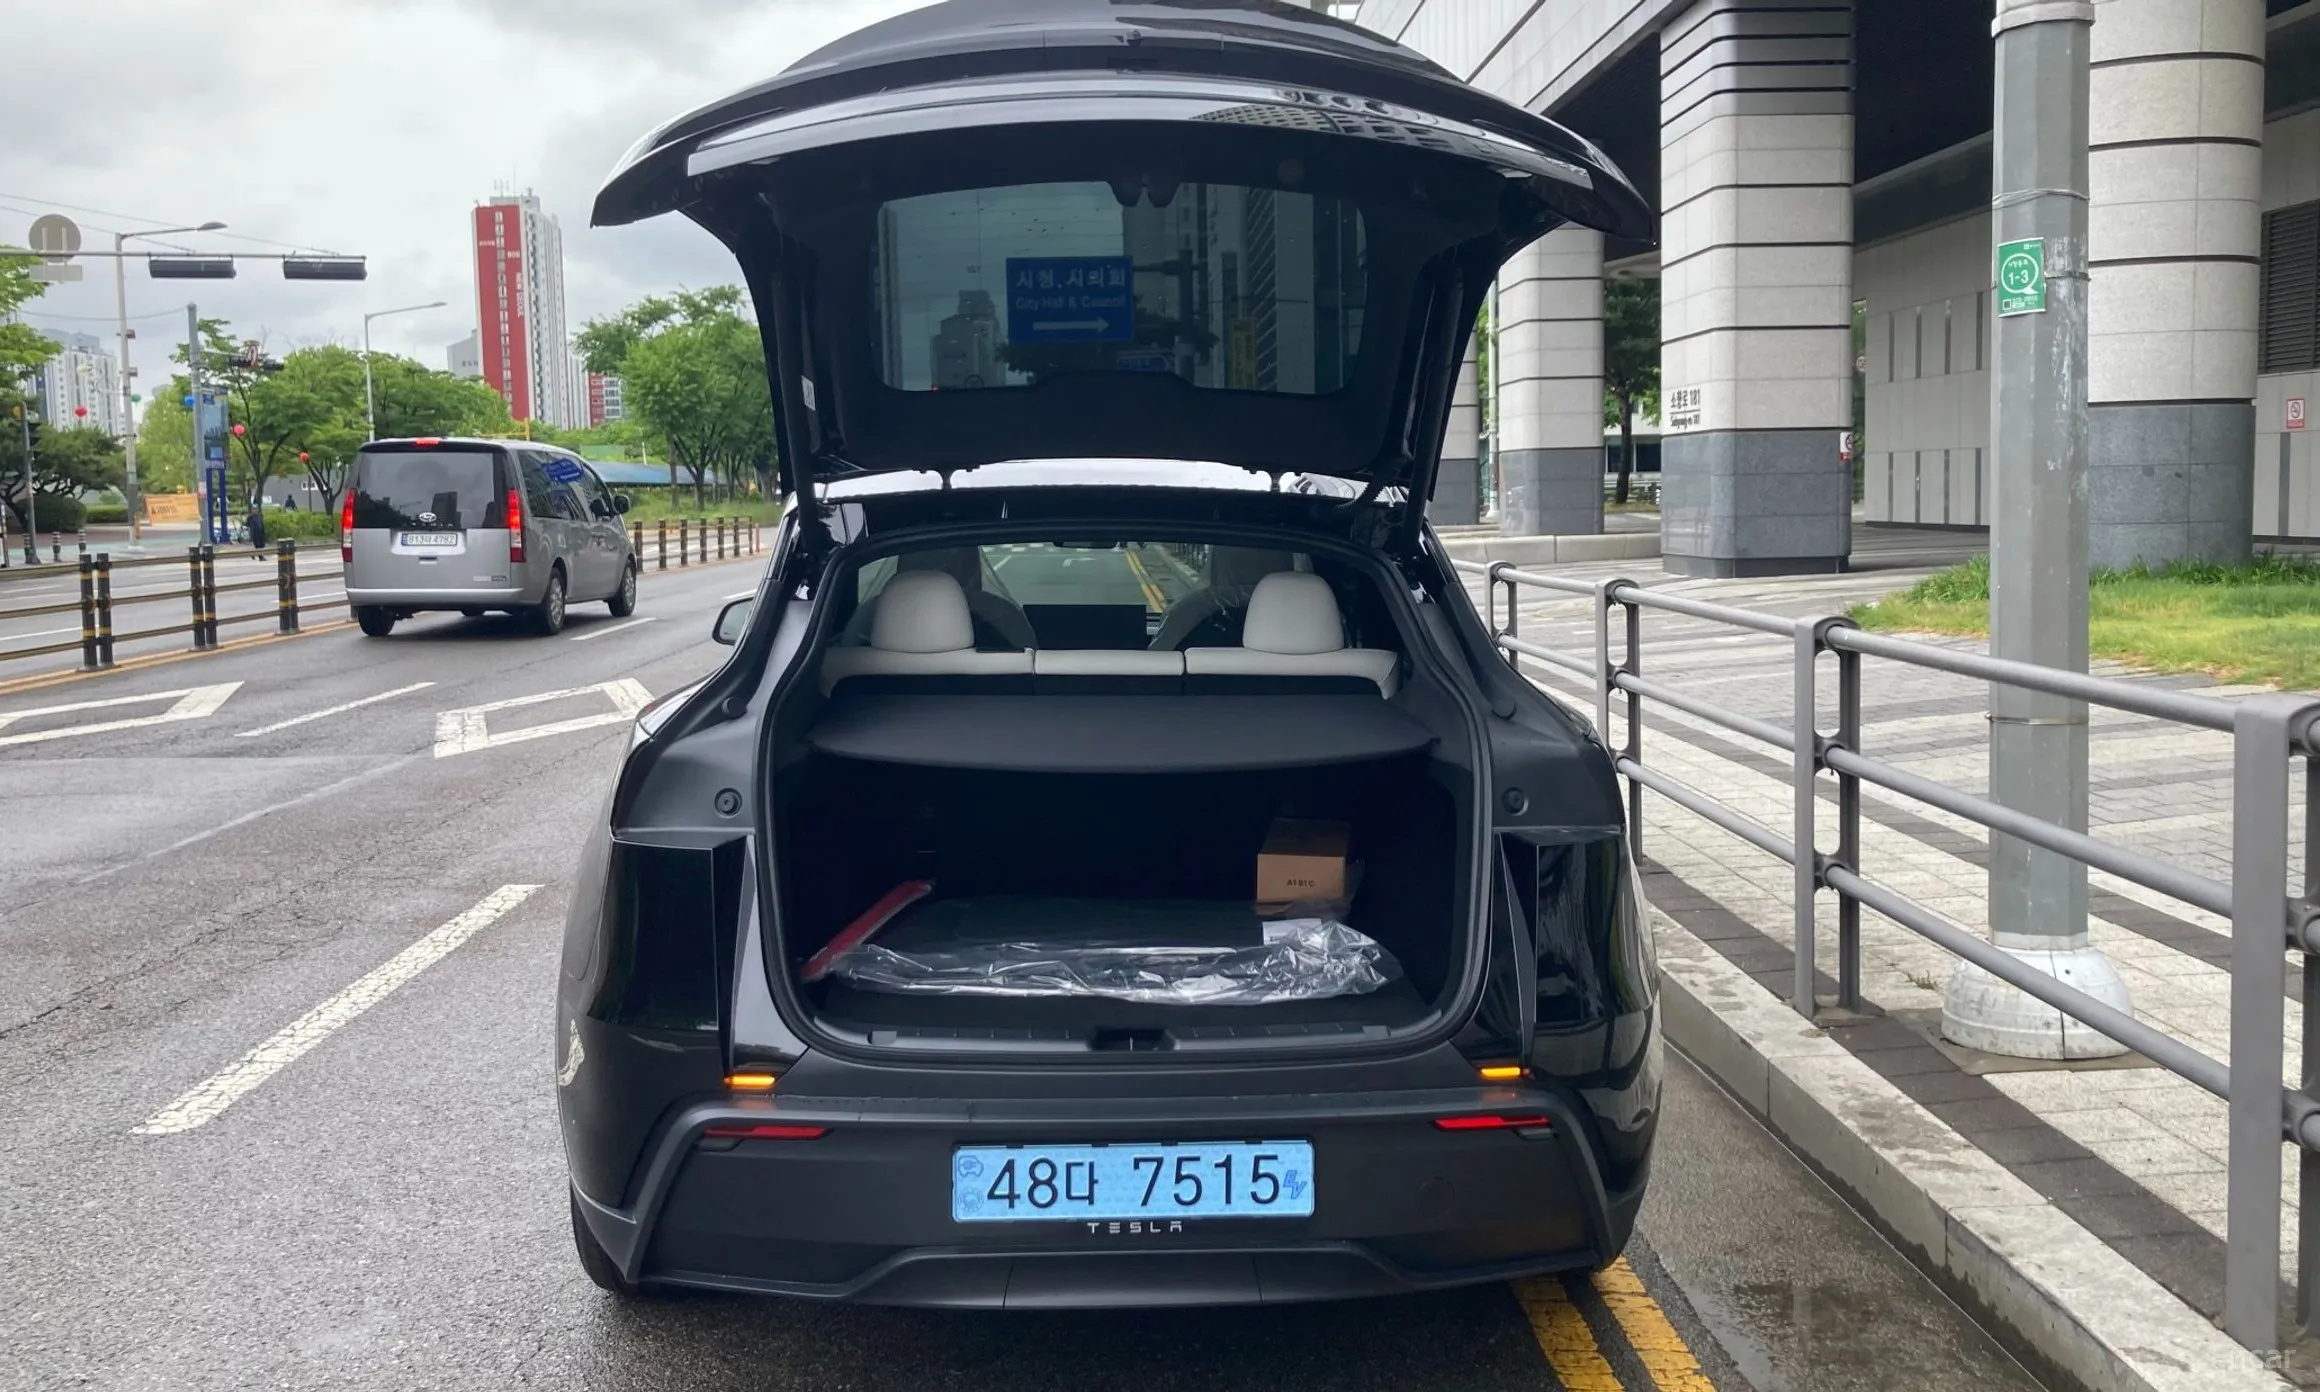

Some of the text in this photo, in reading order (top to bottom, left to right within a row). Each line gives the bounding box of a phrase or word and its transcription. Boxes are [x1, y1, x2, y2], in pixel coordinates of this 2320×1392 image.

[2008, 269, 2029, 285] 1-3
[1690, 388, 1700, 406] 181
[986, 1153, 1280, 1209] 48다 7515
[1087, 1220, 1183, 1235] TESLA
